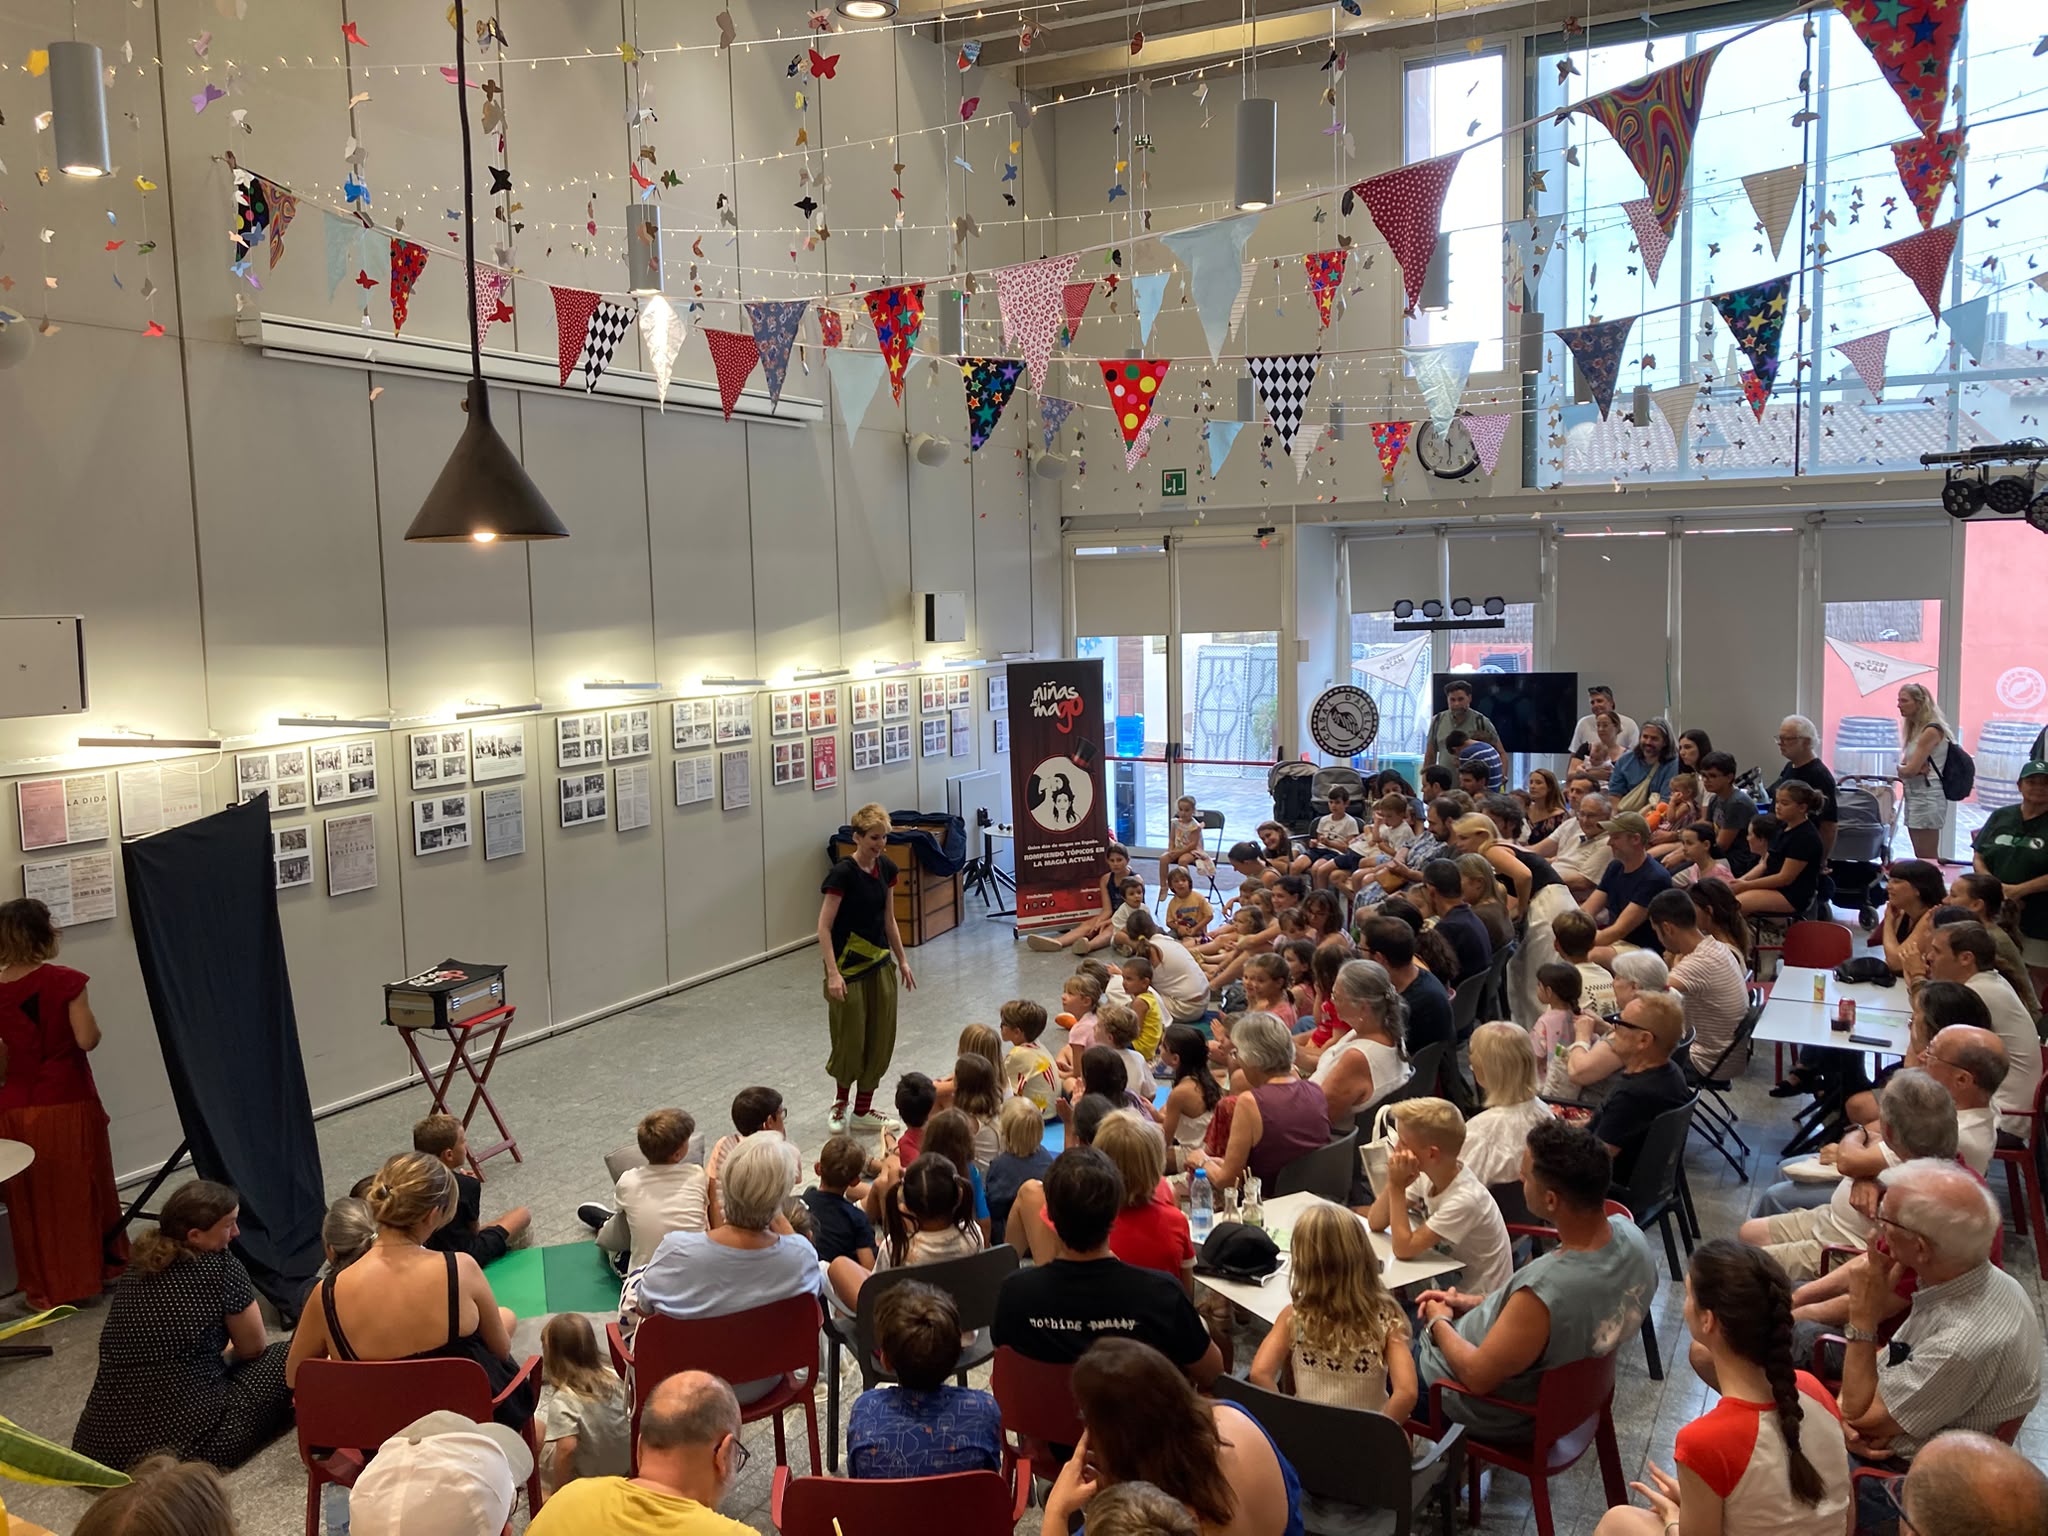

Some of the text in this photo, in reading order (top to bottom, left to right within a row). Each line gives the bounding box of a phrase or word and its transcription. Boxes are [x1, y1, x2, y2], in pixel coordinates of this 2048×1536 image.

[1033, 680, 1080, 701] niñas
[1033, 696, 1084, 734] mago
[1319, 701, 1335, 741] CASAL
[66, 795, 107, 807] LA DIDA
[1023, 850, 1065, 861] ROMPIENDO
[1066, 847, 1094, 857] TÓPICOS
[1044, 858, 1068, 867] MAGIA
[1068, 855, 1096, 864] ACTUAL
